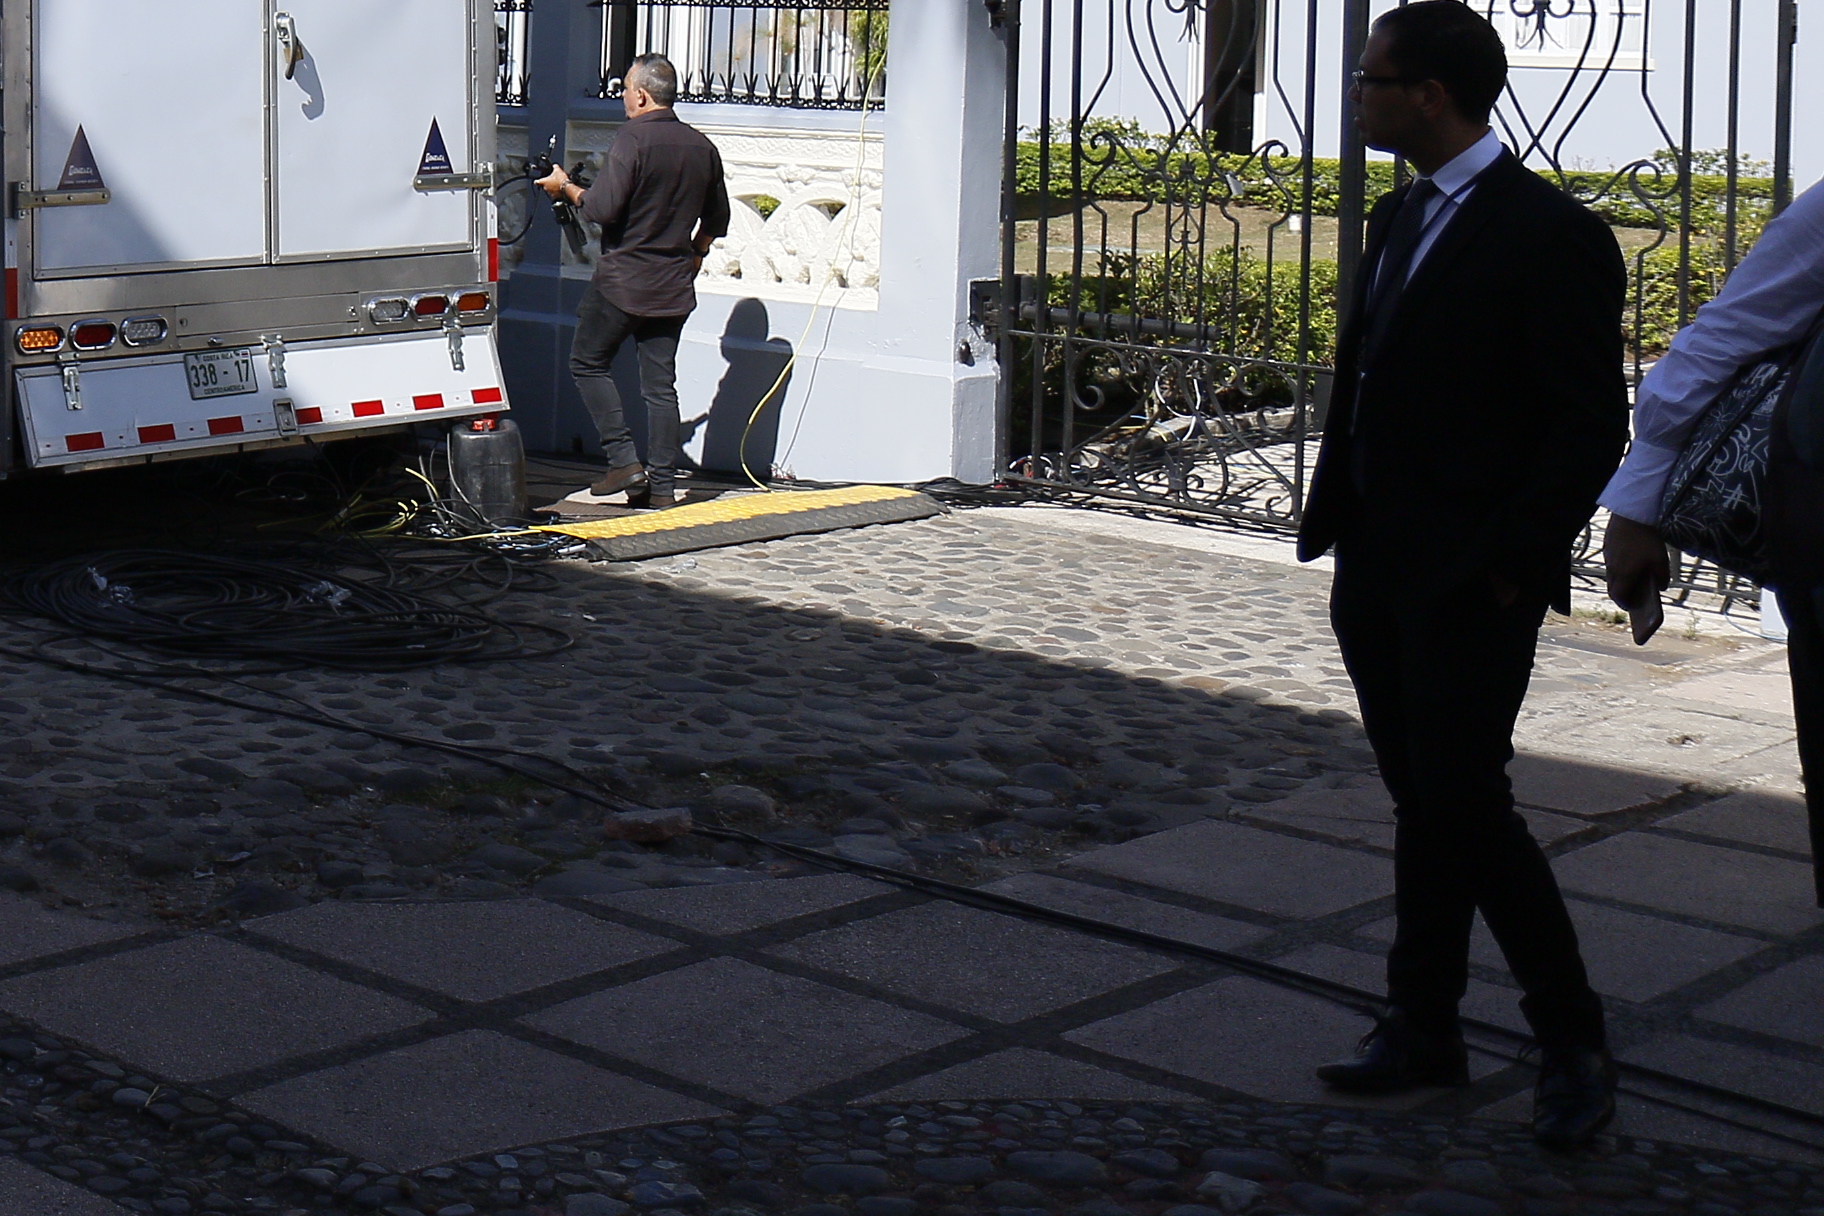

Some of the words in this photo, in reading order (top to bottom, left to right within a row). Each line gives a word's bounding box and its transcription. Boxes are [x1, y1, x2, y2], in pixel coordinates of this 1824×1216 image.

[203, 353, 219, 362] COSTA
[190, 363, 218, 387] 338
[234, 359, 249, 383] 17
